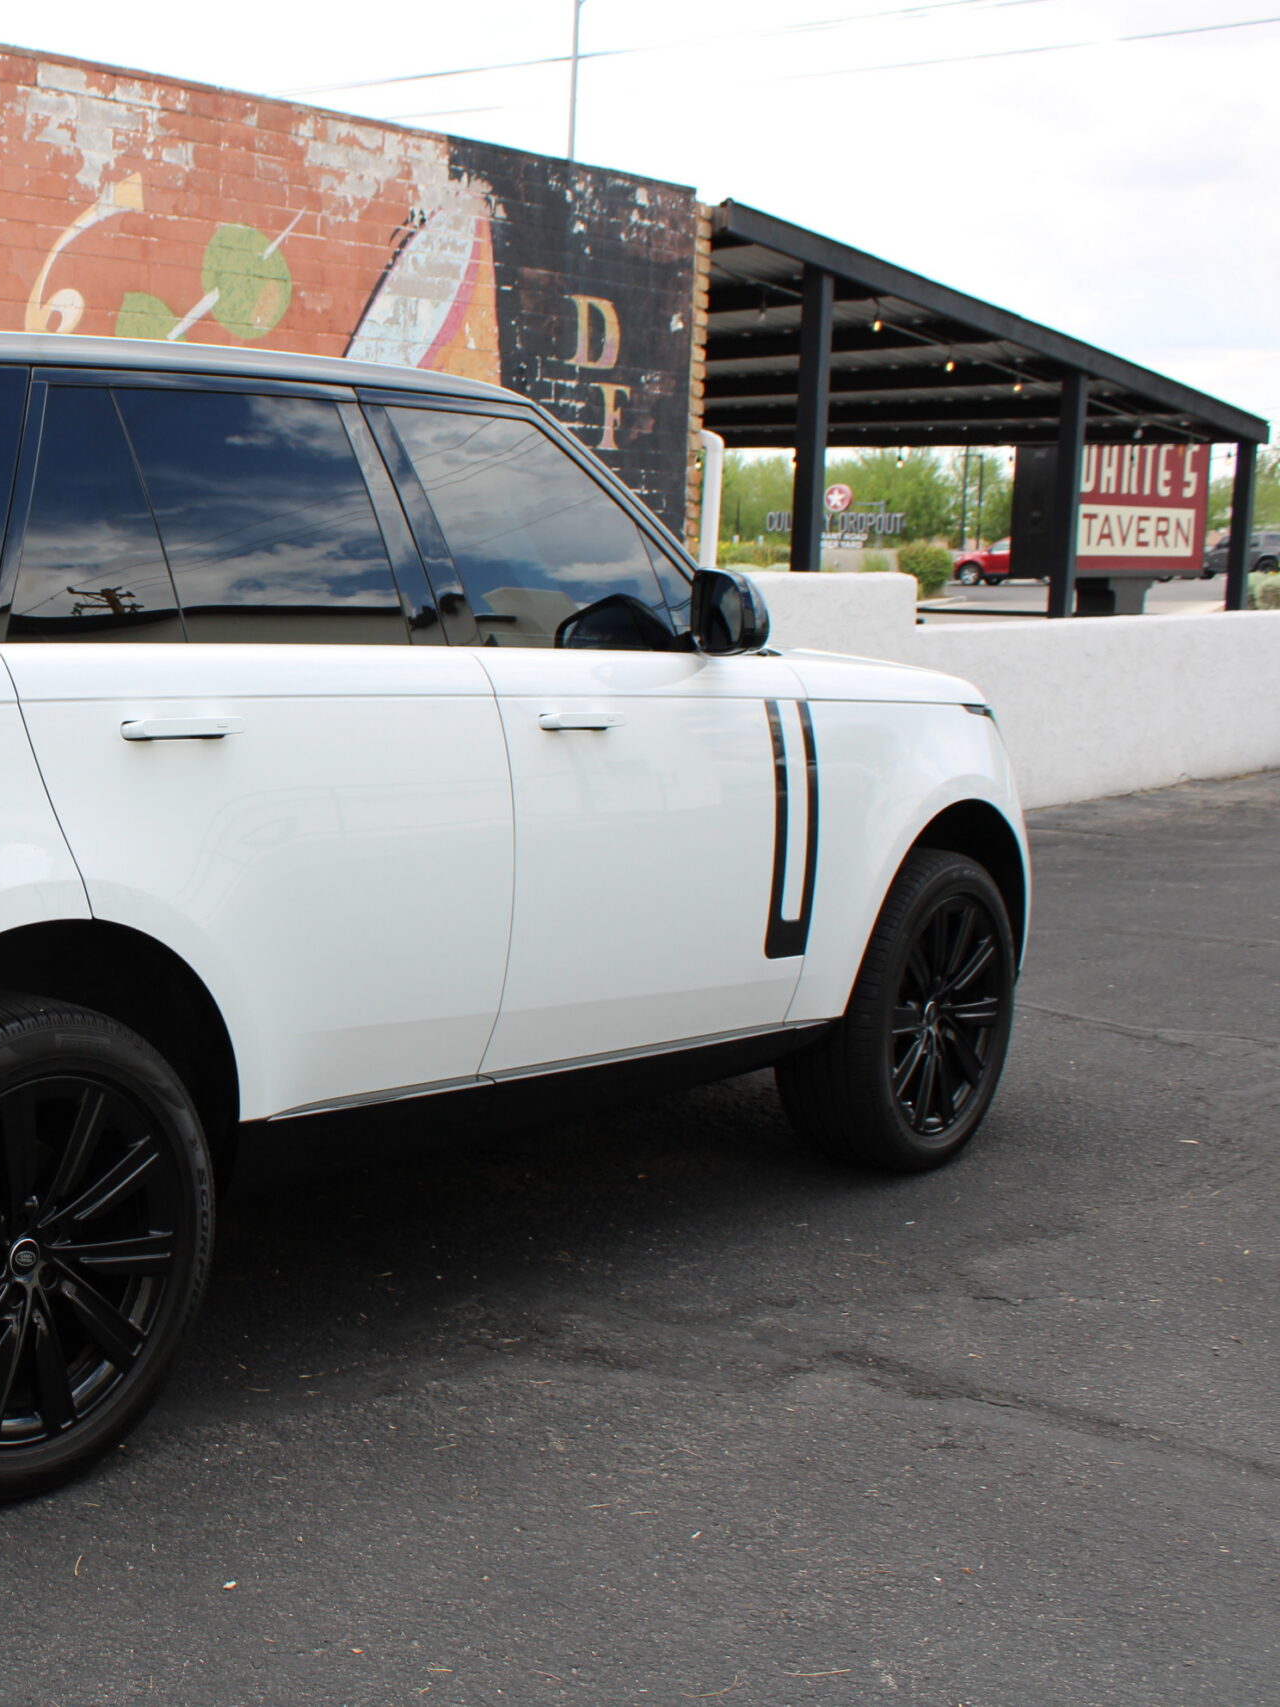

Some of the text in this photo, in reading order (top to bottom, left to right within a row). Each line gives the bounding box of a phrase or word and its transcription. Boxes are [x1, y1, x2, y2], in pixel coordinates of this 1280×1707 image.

[564, 294, 620, 369] D
[838, 512, 905, 534] DROPOUT
[1082, 513, 1192, 548] TAVERN
